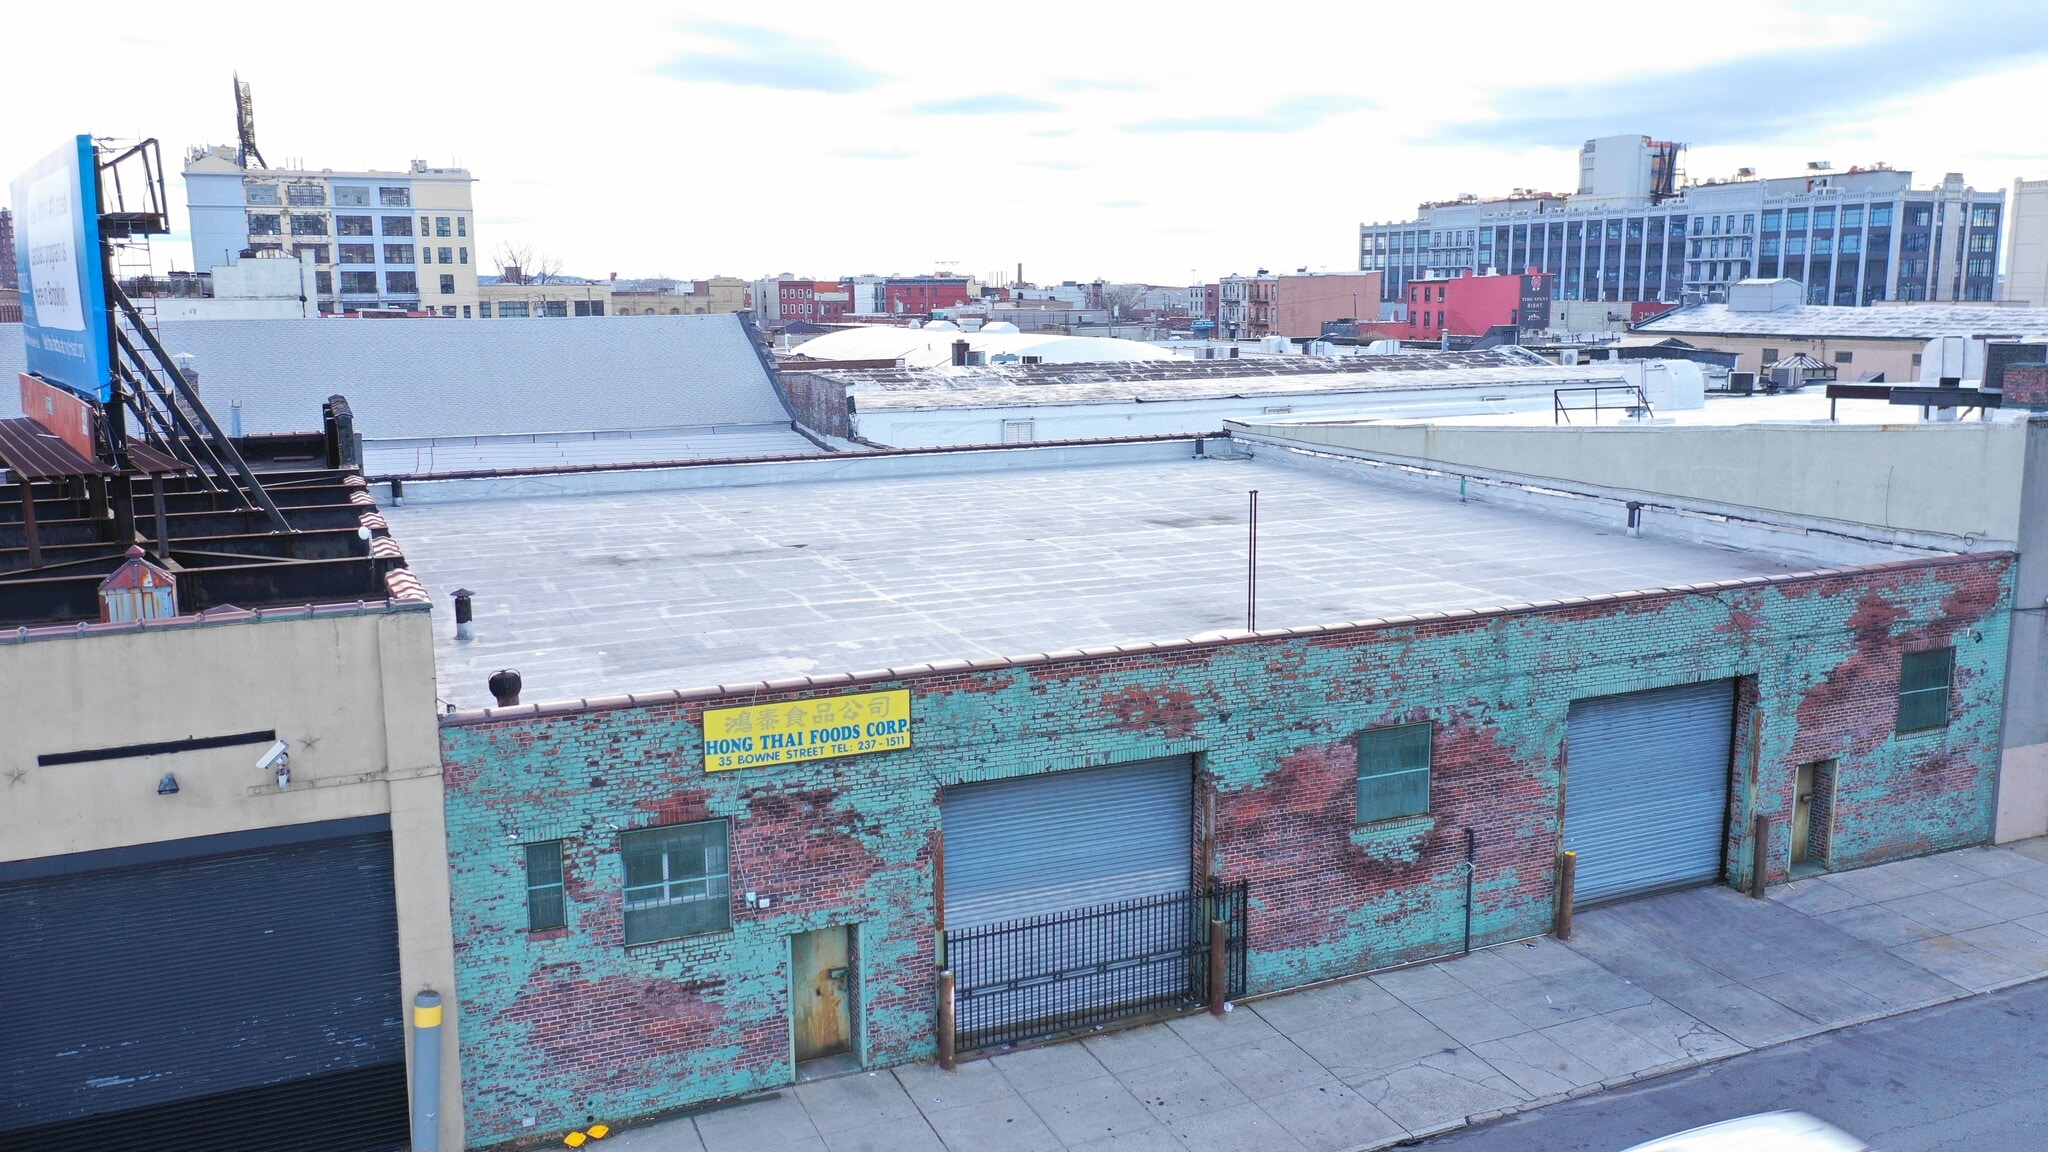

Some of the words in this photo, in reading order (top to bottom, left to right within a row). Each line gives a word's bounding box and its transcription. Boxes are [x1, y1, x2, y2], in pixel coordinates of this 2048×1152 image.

[705, 736, 753, 756] HONG
[760, 732, 804, 750] THAI
[810, 724, 860, 744] FOODS
[866, 718, 910, 738] CORP.
[718, 756, 732, 766] 35
[738, 751, 780, 765] BOWNE
[786, 746, 825, 760] STREET
[831, 744, 853, 754] TEL:
